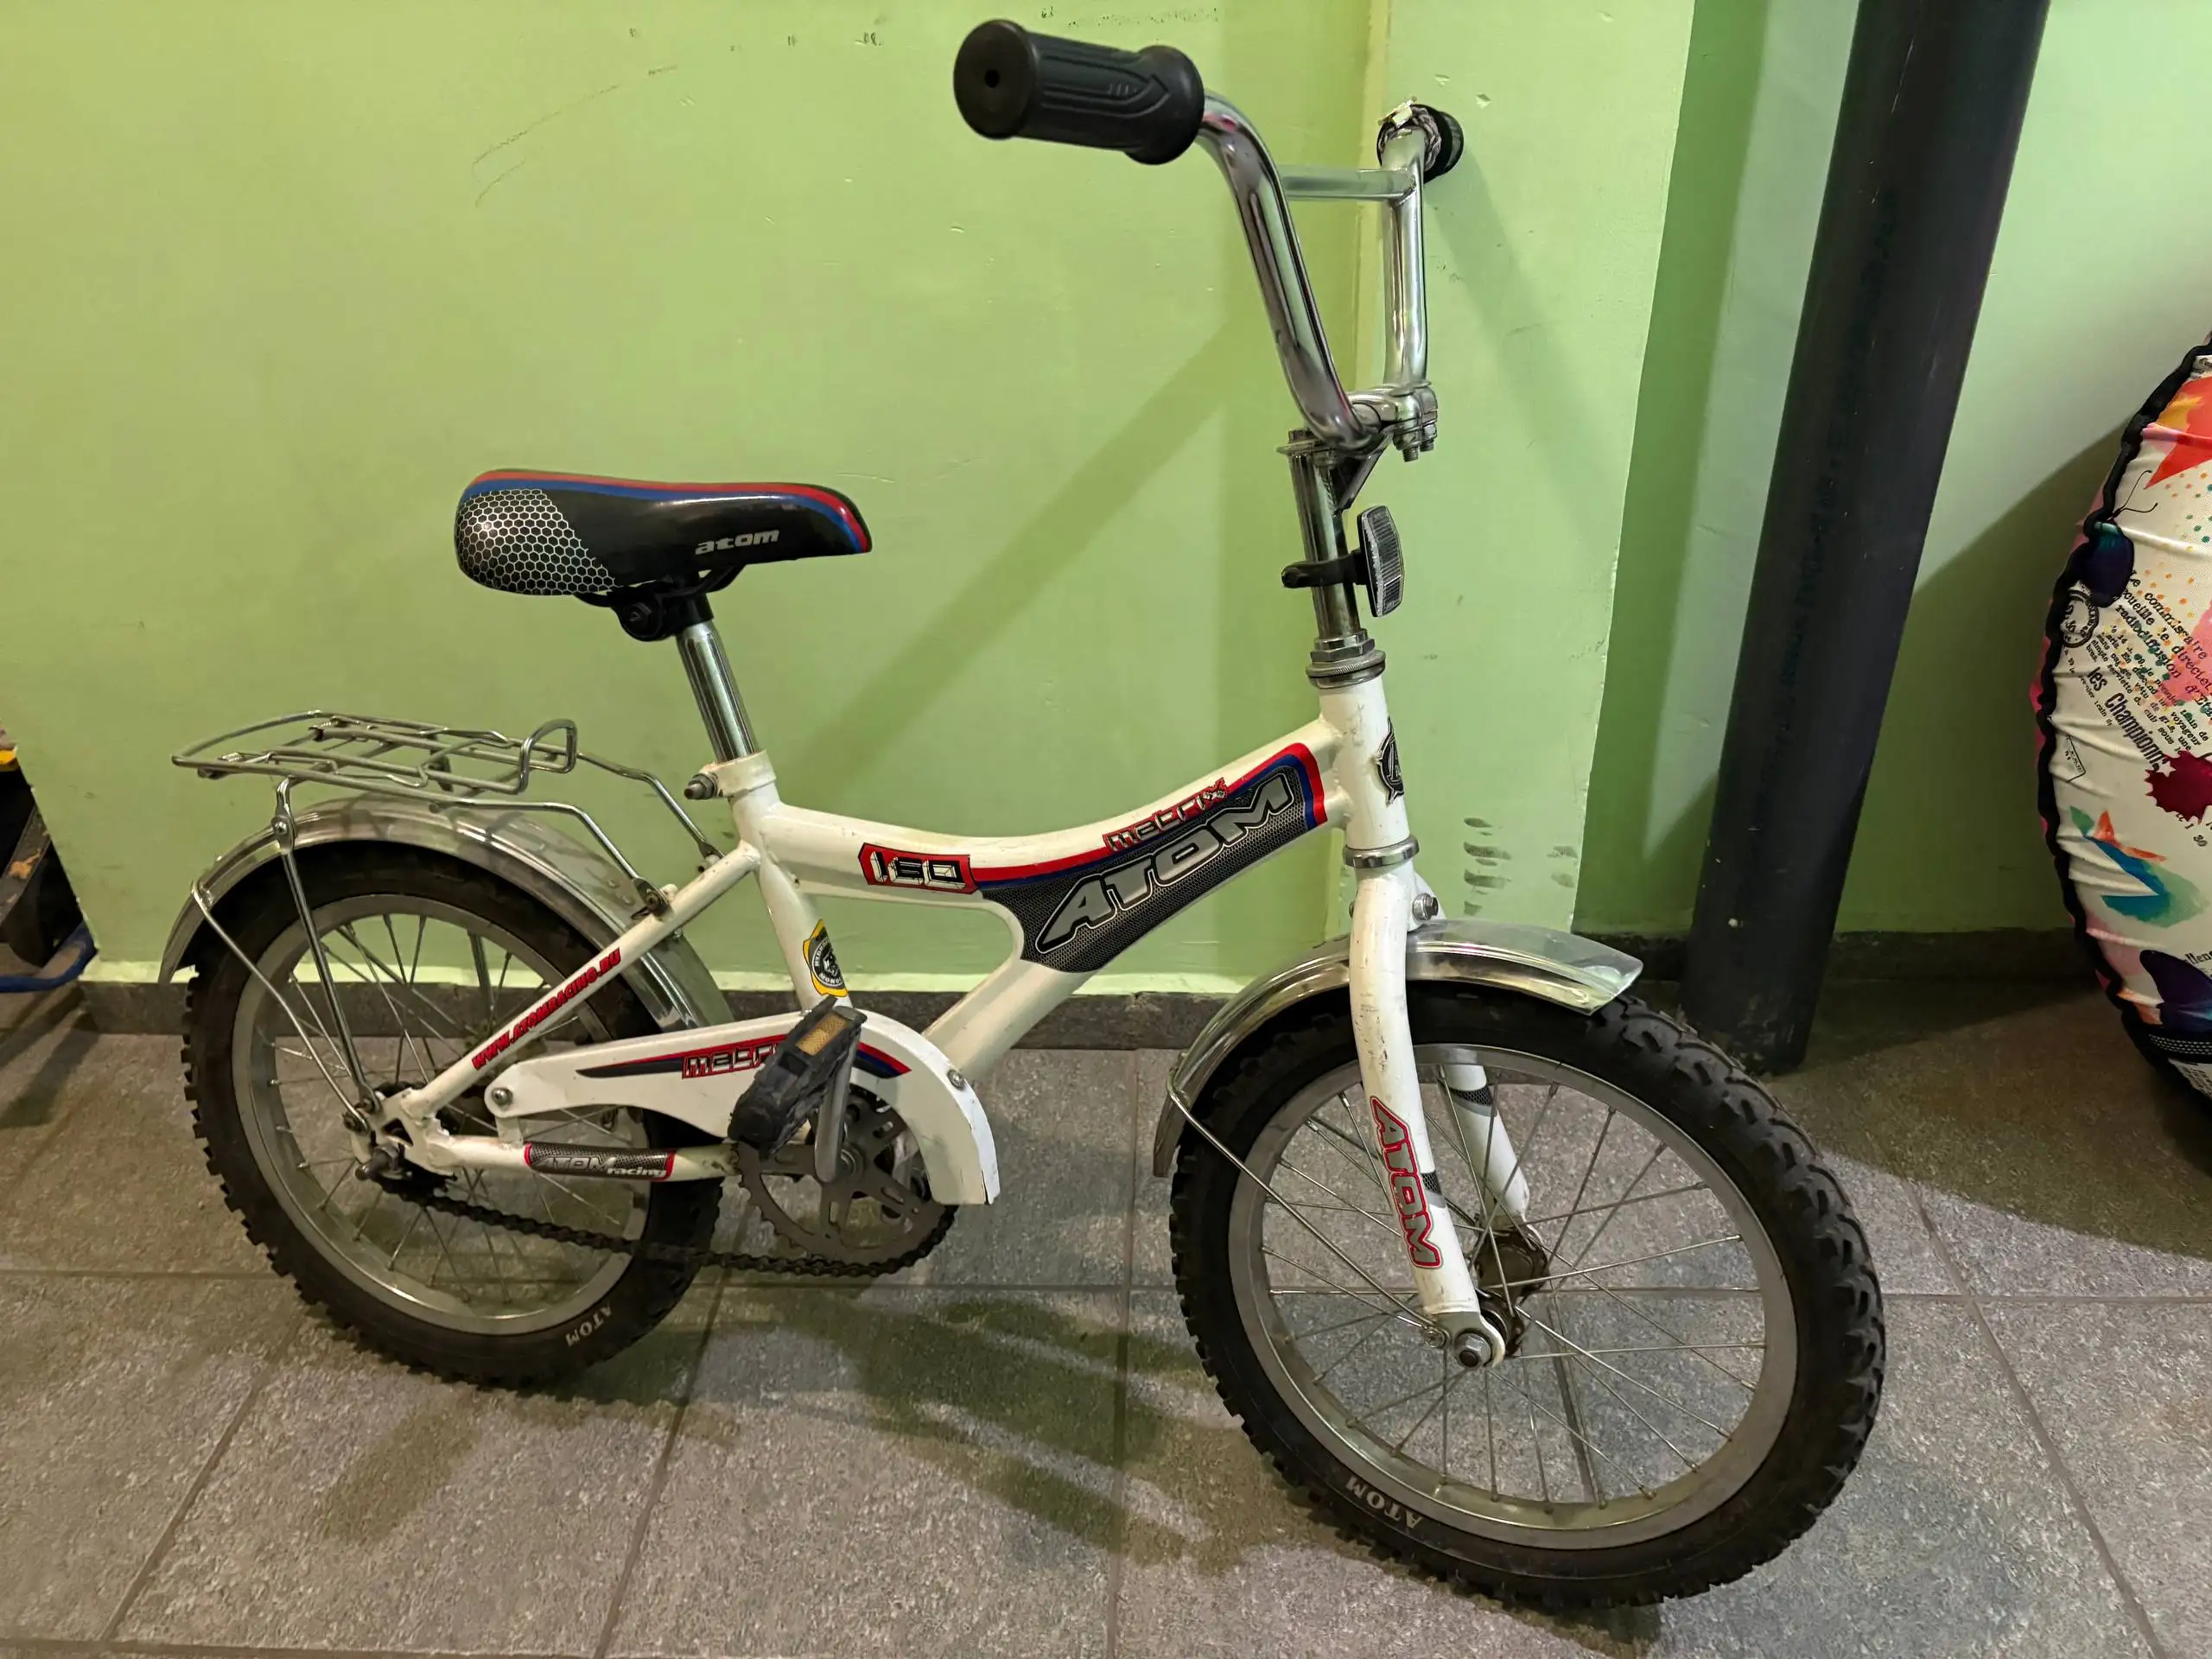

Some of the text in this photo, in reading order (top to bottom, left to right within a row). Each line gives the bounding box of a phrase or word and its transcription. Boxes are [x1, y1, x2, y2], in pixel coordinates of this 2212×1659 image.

[696, 529, 779, 556] atom
[2086, 665, 2109, 692] les
[2157, 727, 2176, 746] sous
[2170, 710, 2202, 747] voyageur
[1037, 774, 1294, 953] ATOM
[532, 1154, 667, 1179] ATOM racing
[1370, 1096, 1442, 1268] ATOM
[565, 1302, 612, 1347] ATOM
[1344, 1476, 1423, 1529] ATOM
